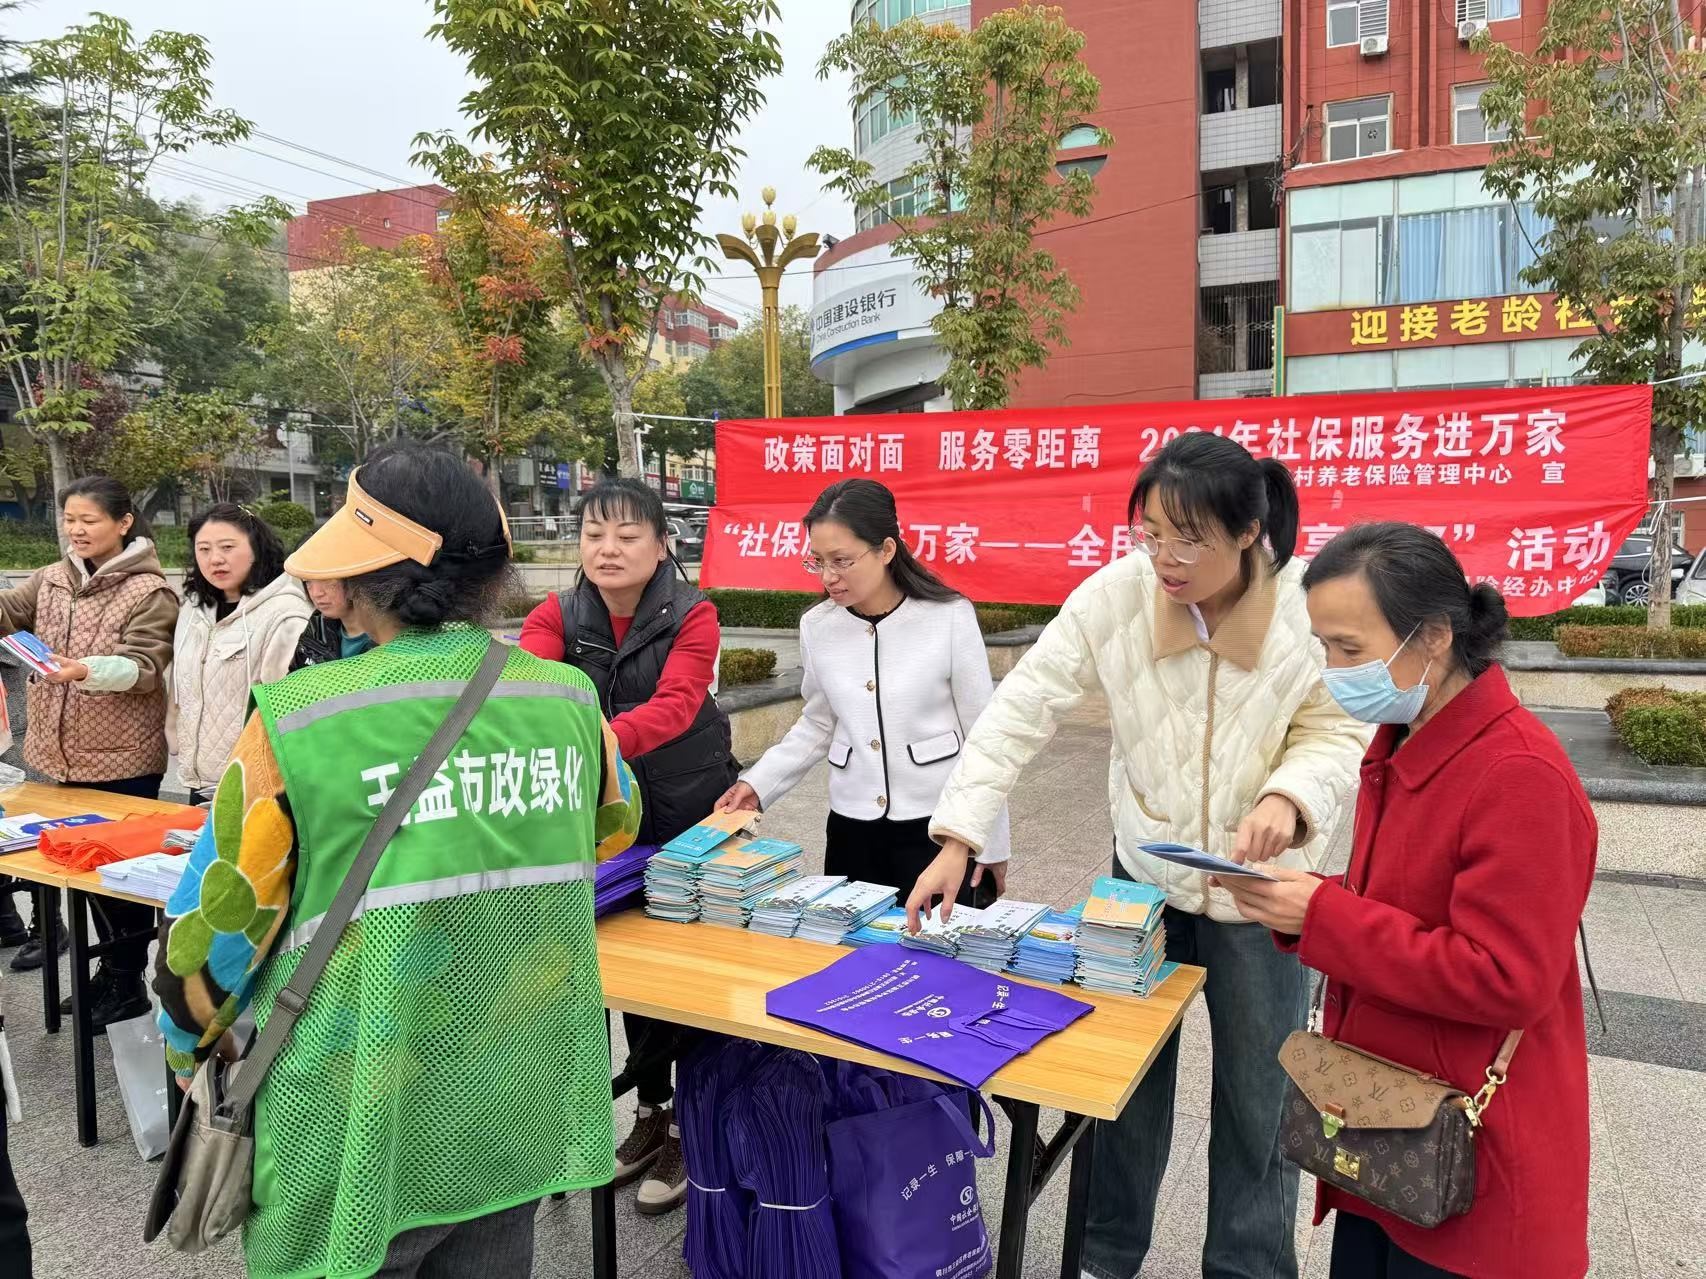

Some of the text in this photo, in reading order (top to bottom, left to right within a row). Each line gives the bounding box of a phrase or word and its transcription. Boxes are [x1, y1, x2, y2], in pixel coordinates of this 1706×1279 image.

[815, 288, 896, 331] 中国建设银行
[827, 319, 860, 339] Construction
[861, 312, 881, 326] Bank
[764, 408, 1567, 473] 政策面对面 服务零距离 20年社保服务进万家
[1294, 461, 1566, 488] 村养老保险管理中心 宣
[1506, 520, 1611, 571] 活动
[1465, 568, 1599, 598] 险经办中心
[901, 1164, 938, 1201] 记录一生
